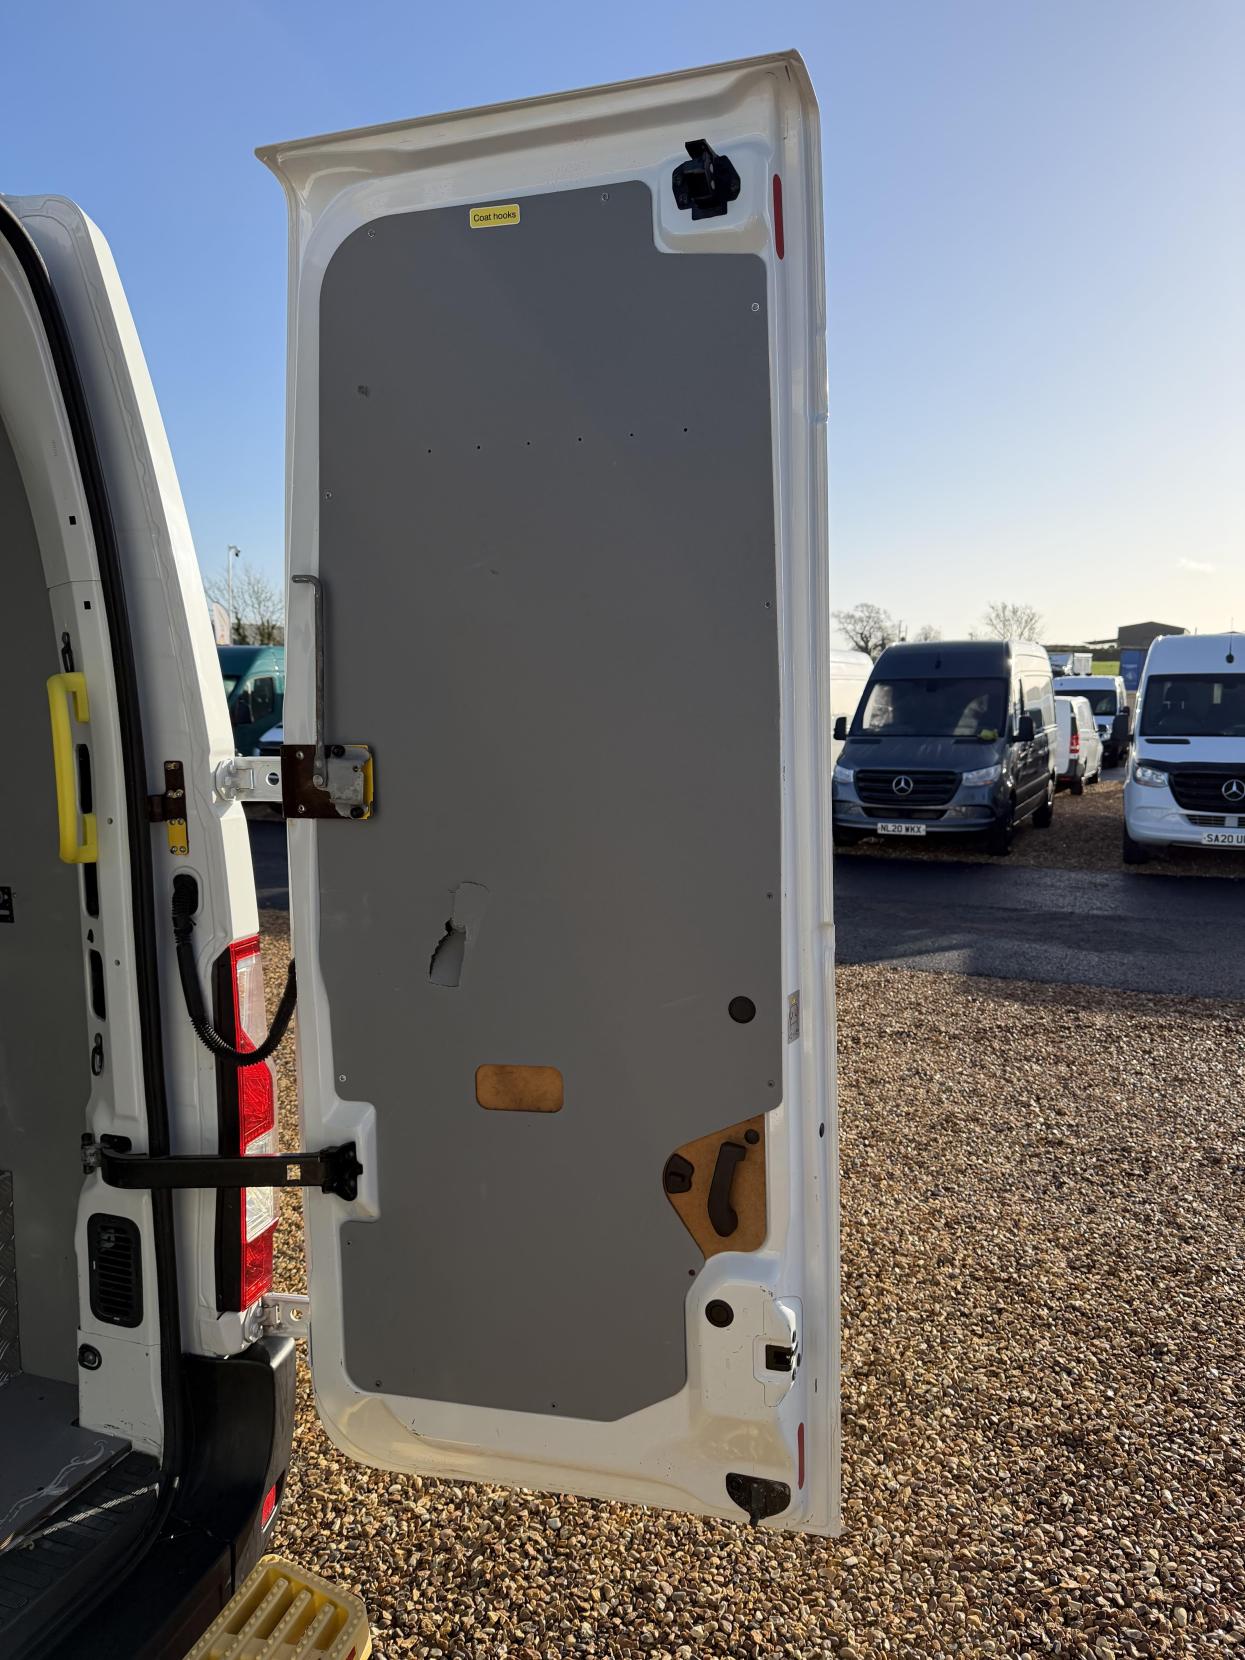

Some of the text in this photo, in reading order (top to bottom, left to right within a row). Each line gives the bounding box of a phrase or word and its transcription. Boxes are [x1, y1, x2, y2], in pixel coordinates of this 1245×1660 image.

[473, 211, 517, 222] Coat hooks
[880, 824, 922, 834] NL20 WKX
[1206, 833, 1234, 844] SA20
